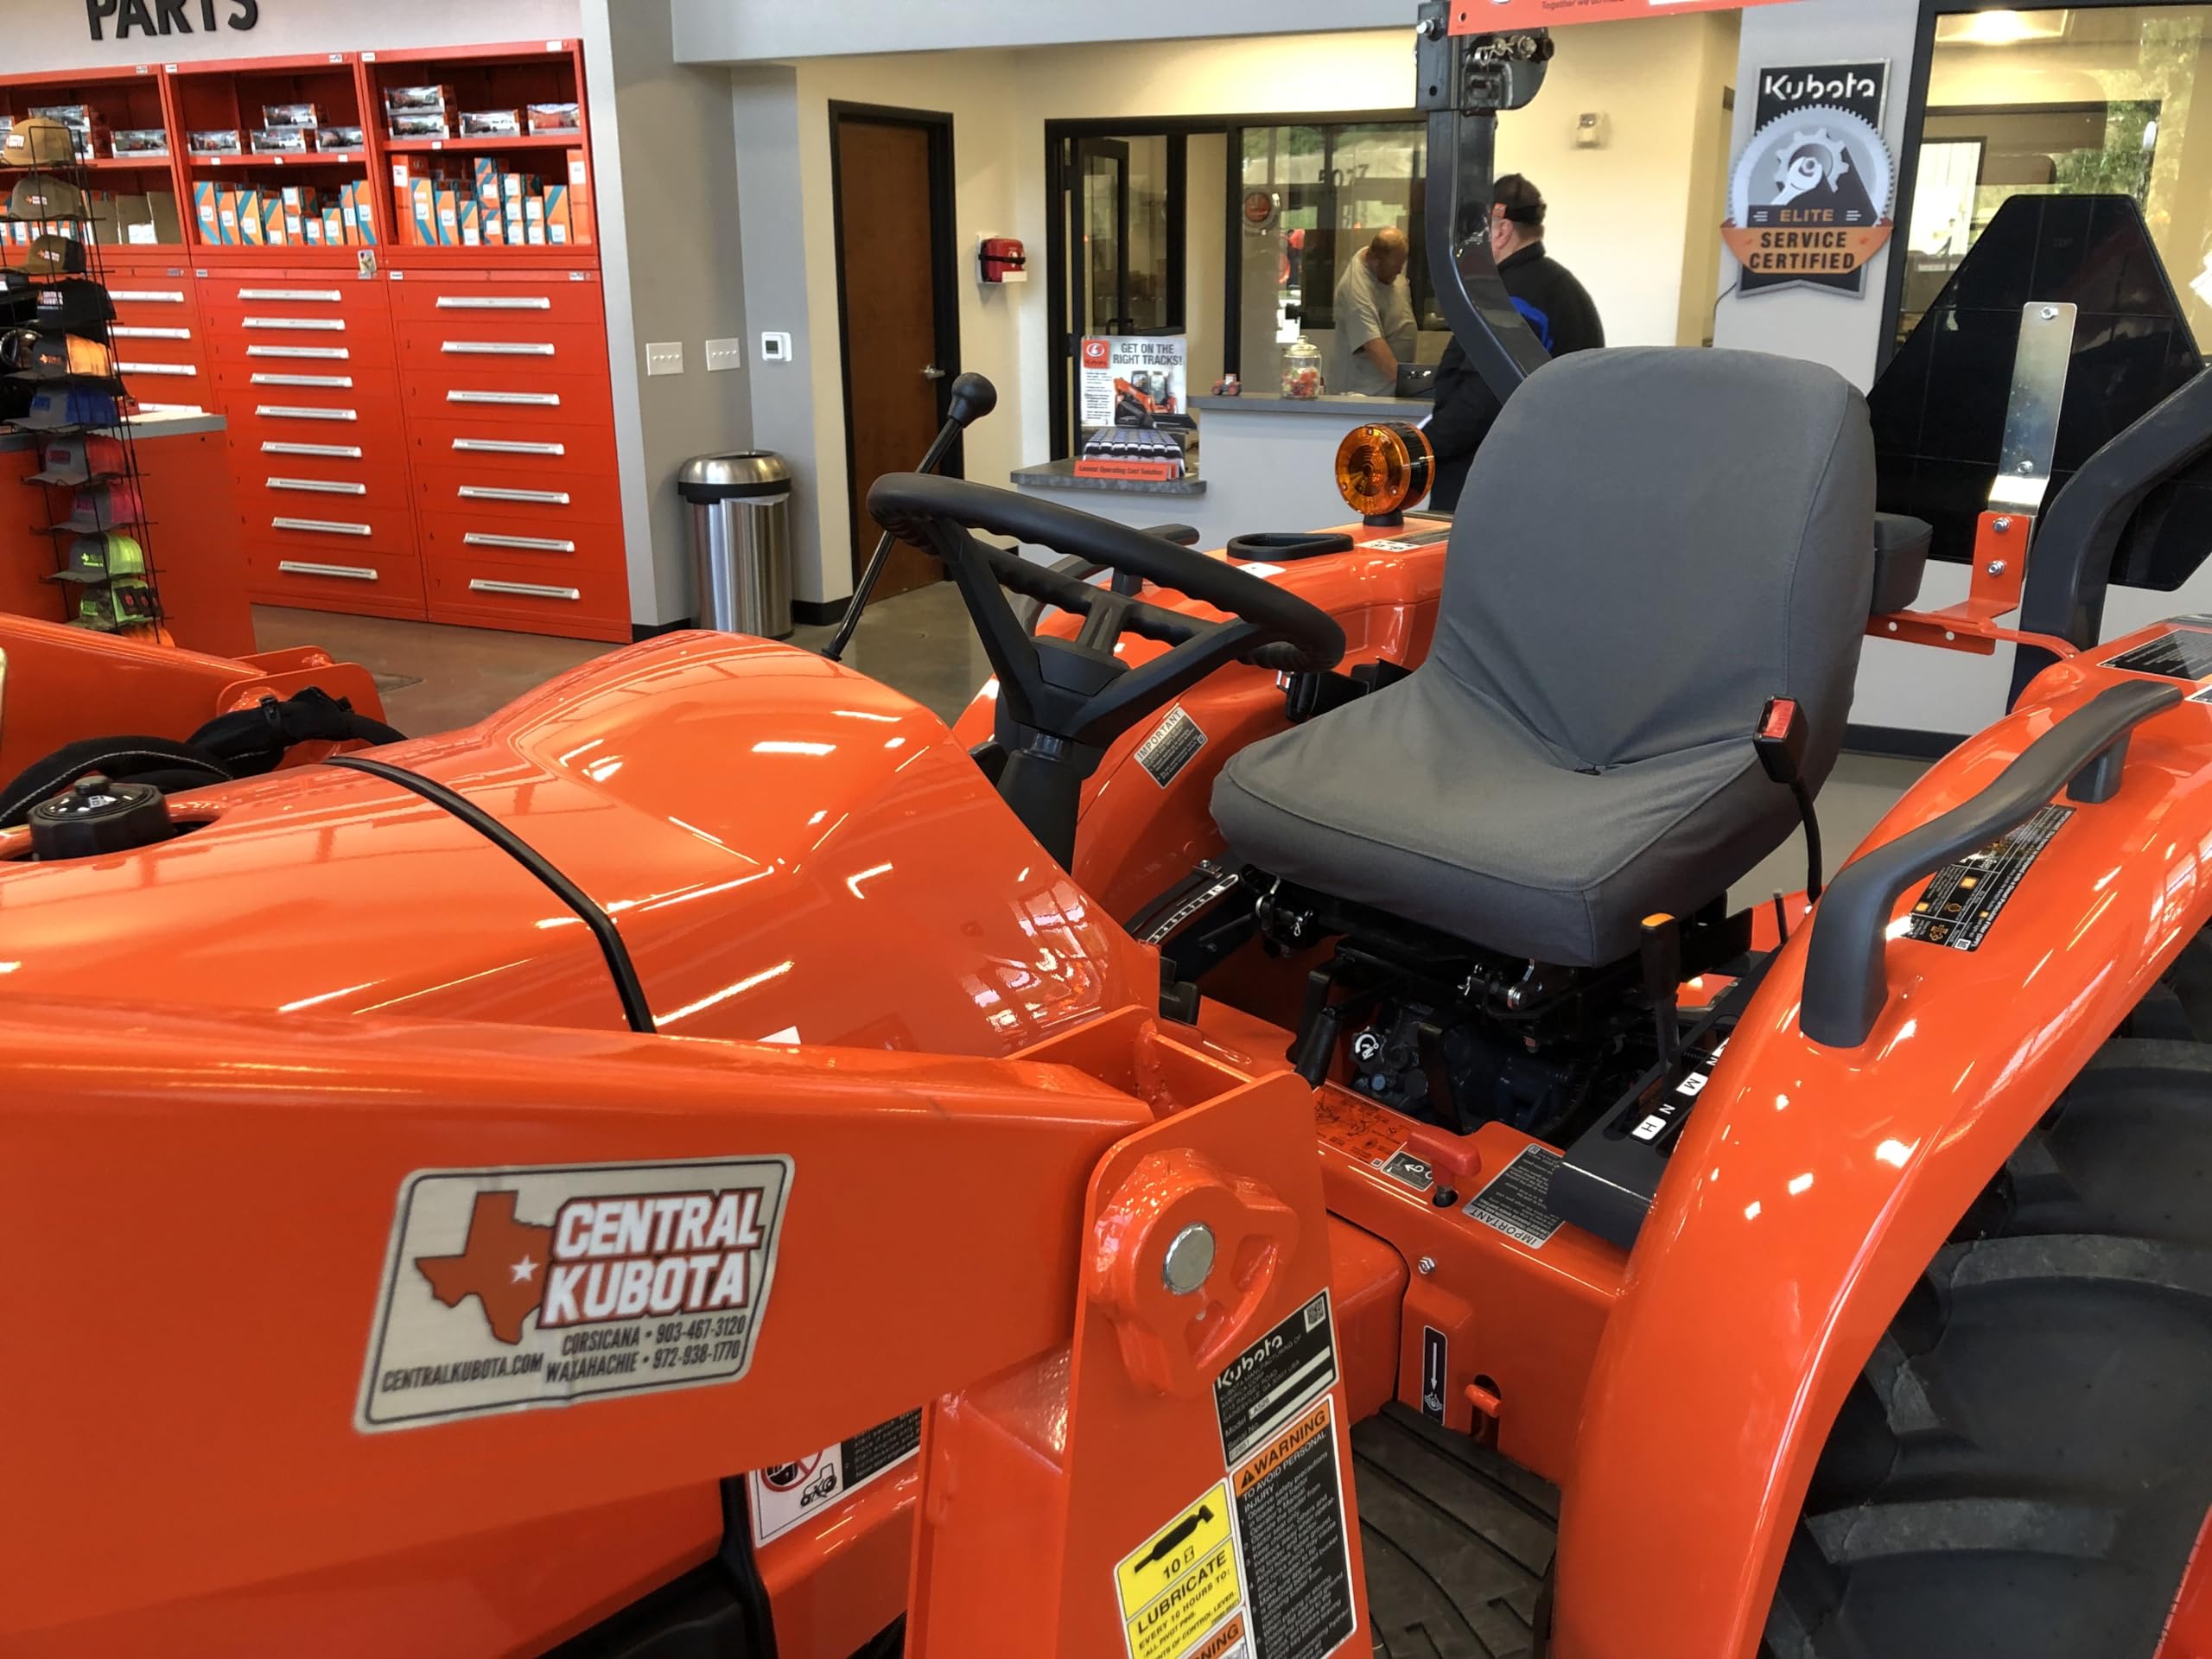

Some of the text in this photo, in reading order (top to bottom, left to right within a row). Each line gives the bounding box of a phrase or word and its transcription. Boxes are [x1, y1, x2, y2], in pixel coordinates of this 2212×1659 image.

[87, 0, 257, 40] PARTS
[1764, 73, 1875, 100] Kubota
[1779, 209, 1834, 222] ELITE
[1760, 232, 1847, 249] SERVICE
[1749, 252, 1856, 270] CERTIFIED
[1113, 354, 1182, 365] RIGHT TRACKS!
[1121, 343, 1174, 354] GET ON THE
[1136, 709, 1181, 760] IMPORTANT
[1684, 1078, 1701, 1090] M
[1641, 1122, 1657, 1133] H
[1658, 1103, 1675, 1115] N
[550, 1189, 770, 1263] CENTRAL
[1468, 1207, 1537, 1245] IMPORTANT
[540, 1248, 754, 1326] KUBOTA
[559, 1313, 748, 1357] CORSICANA 903-467-3120
[379, 1351, 546, 1395] CENTRALKUBOTA.COM
[542, 1338, 743, 1386] WAXAHACHIE 972-938-1770
[1217, 1335, 1282, 1389] Kubota
[1253, 1408, 1325, 1478] WARNING
[1243, 1428, 1325, 1503] TO AVOID PERSONAL
[1244, 1482, 1274, 1514] INJURY
[1162, 1554, 1181, 1582] 10
[1137, 1548, 1226, 1636] LUBRICATE
[1138, 1618, 1168, 1651] EVERY
[1171, 1608, 1180, 1623] 10
[1182, 1580, 1213, 1613] HOURS
[1159, 1623, 1179, 1646] PIVOT
[1181, 1609, 1211, 1641] CONTROL
[1196, 1620, 1239, 1659] NING
